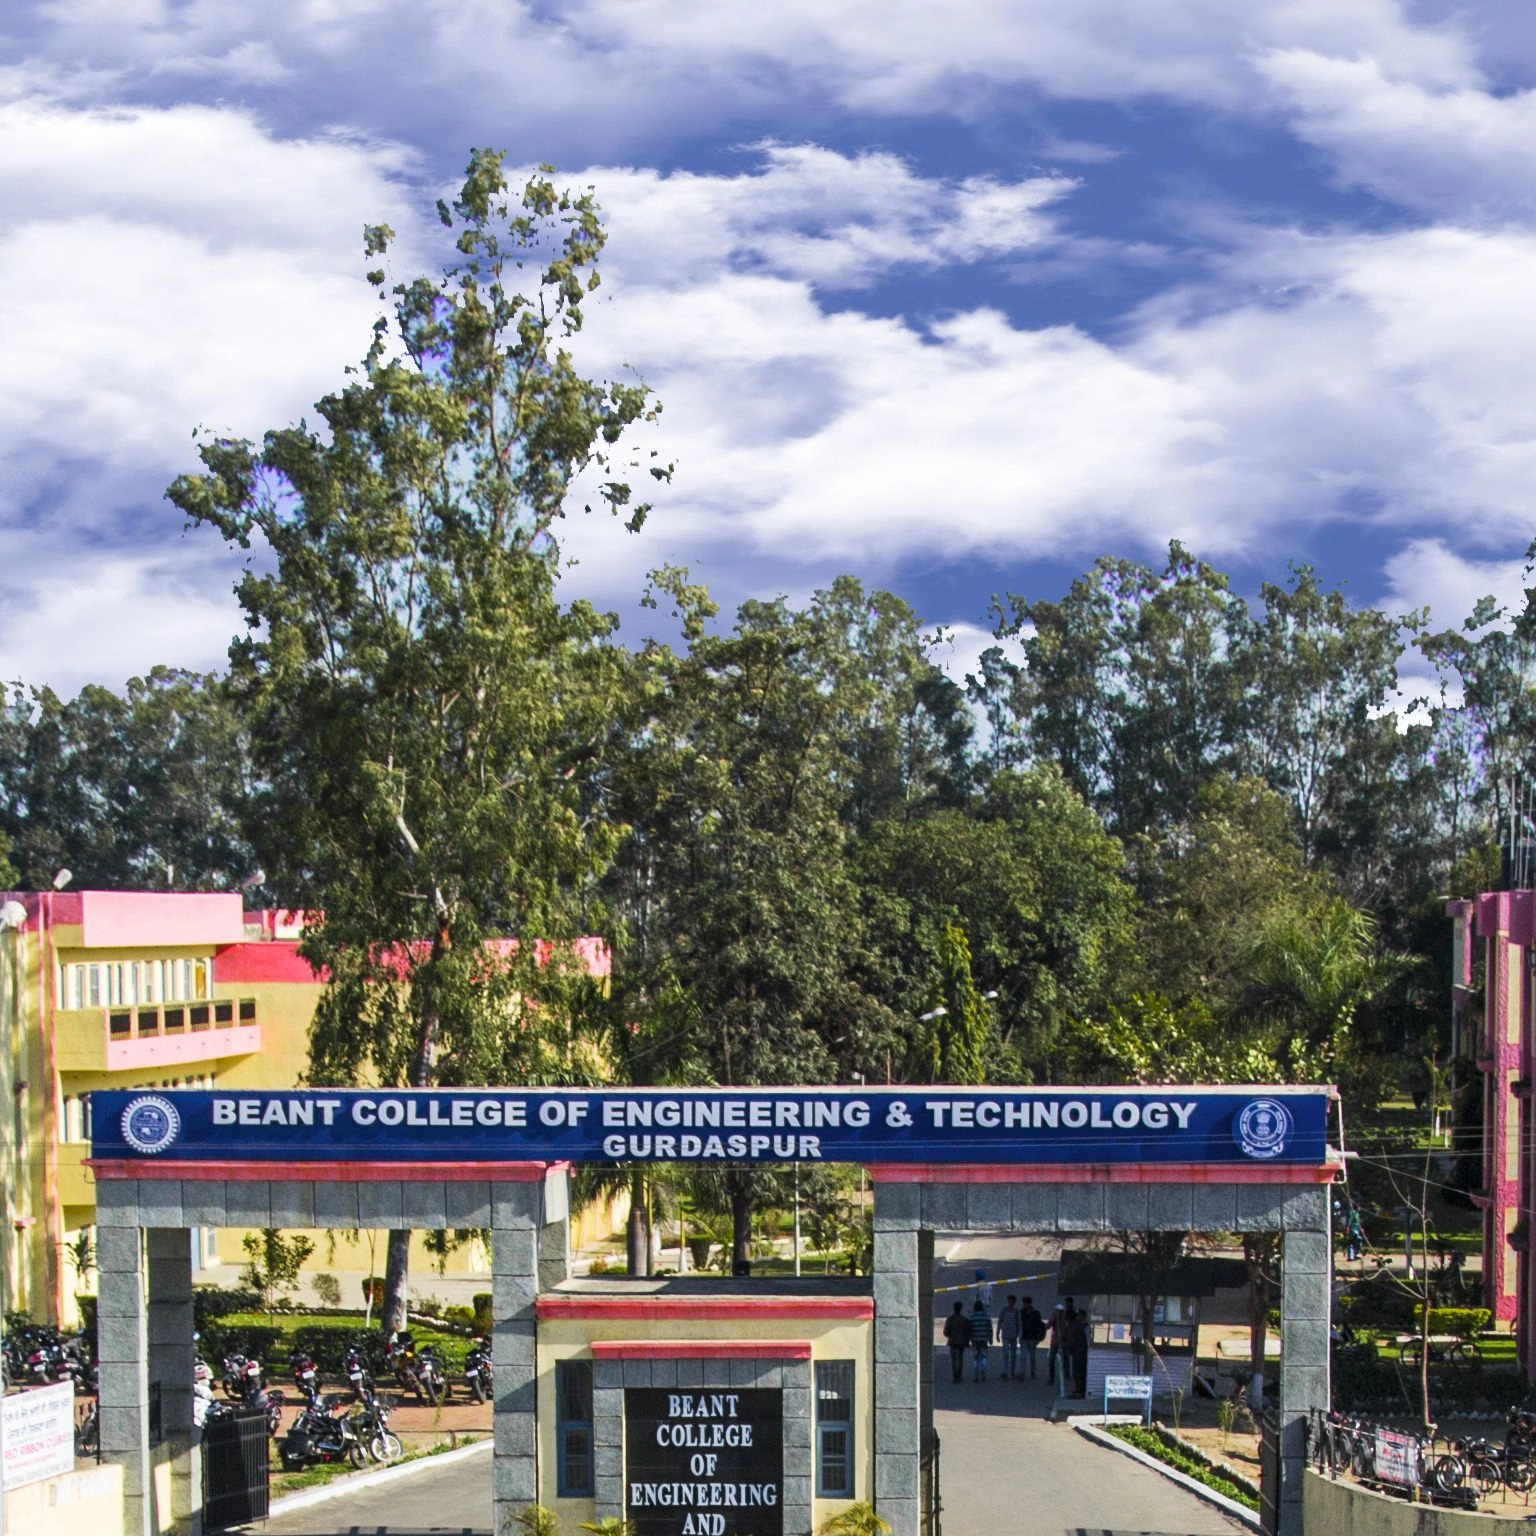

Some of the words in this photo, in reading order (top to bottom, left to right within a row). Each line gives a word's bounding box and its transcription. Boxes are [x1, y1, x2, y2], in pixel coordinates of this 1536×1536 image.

[213, 1099, 341, 1125] BEANT
[352, 1099, 527, 1127] COLLEGE
[539, 1100, 589, 1127] OF
[603, 1100, 870, 1127] ENGINEERING
[885, 1101, 913, 1127] &
[925, 1101, 1197, 1129] TECHNOLOGY
[603, 1134, 822, 1159] GURDASPUR
[668, 1394, 739, 1418] BEANT
[656, 1423, 753, 1447] COLLEGE
[690, 1453, 718, 1477] OF
[630, 1482, 777, 1507] ENGINEERING
[681, 1512, 726, 1536] AND
